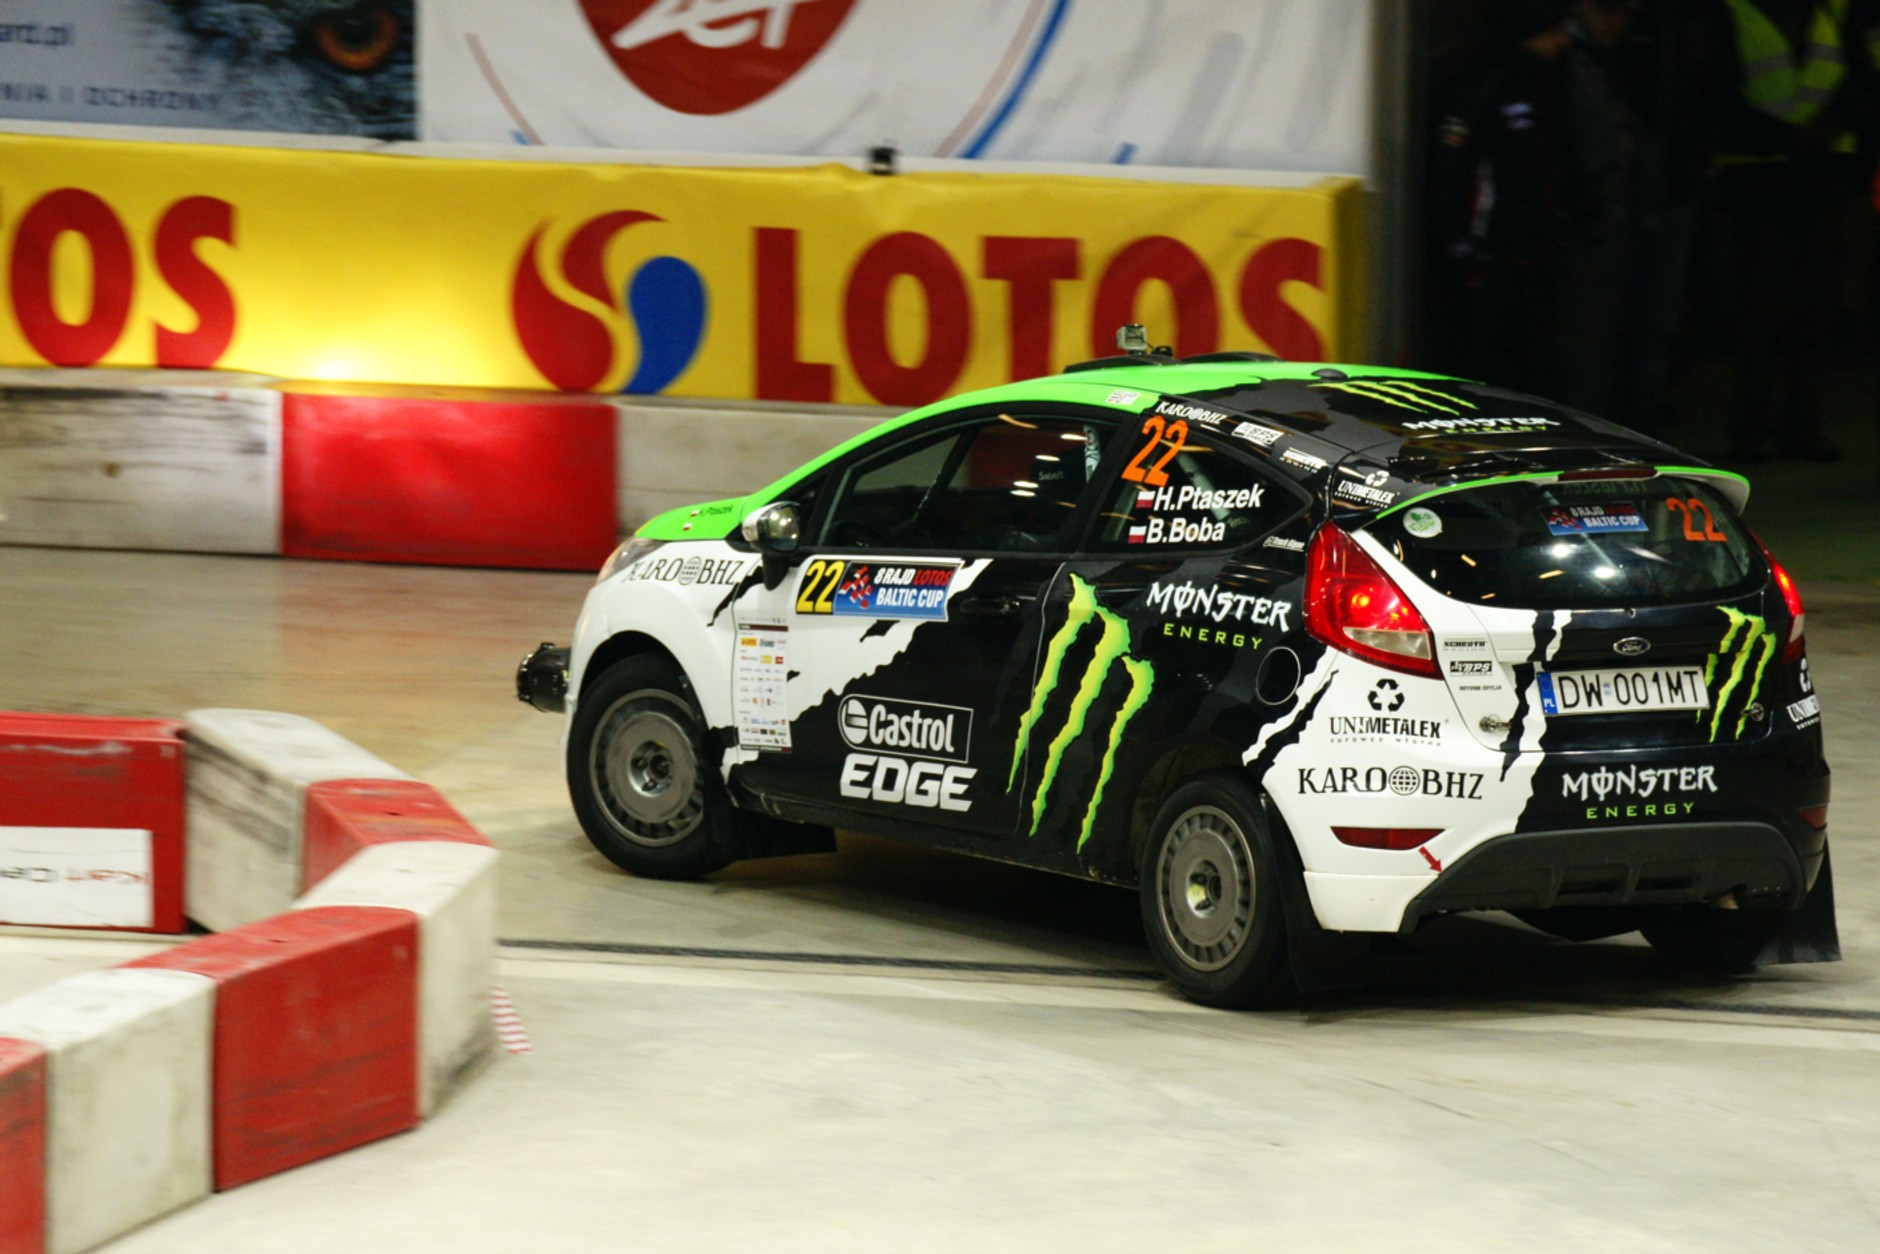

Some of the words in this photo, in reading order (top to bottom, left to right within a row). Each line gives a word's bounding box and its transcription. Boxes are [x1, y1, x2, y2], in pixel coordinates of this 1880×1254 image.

[0, 186, 239, 368] OS
[752, 227, 1328, 406] LOTOS
[1121, 415, 1189, 487] 22
[1153, 483, 1265, 511] H.Ptaszek
[1338, 480, 1395, 504] UNIMETALEX
[1146, 517, 1226, 544] B.Boba
[1583, 517, 1618, 528] BALTIC
[1618, 516, 1641, 526] CUP
[1666, 498, 1728, 541] 22
[796, 560, 846, 613] 22
[884, 567, 916, 585] RAJD
[912, 569, 954, 587] LOTOS
[875, 587, 917, 607] BALTIC
[918, 589, 944, 608] CUP
[1163, 623, 1262, 649] ENERGY
[1544, 698, 1555, 708] PL
[1558, 673, 1604, 709] DW
[1613, 669, 1699, 706] 001MT
[869, 704, 955, 753] Castrol
[1330, 716, 1442, 739] UNIMETALEX
[840, 753, 979, 812] EDGE
[1298, 766, 1388, 794] KARO
[1421, 768, 1485, 800] BHZ
[1586, 802, 1695, 819] ENERGY
